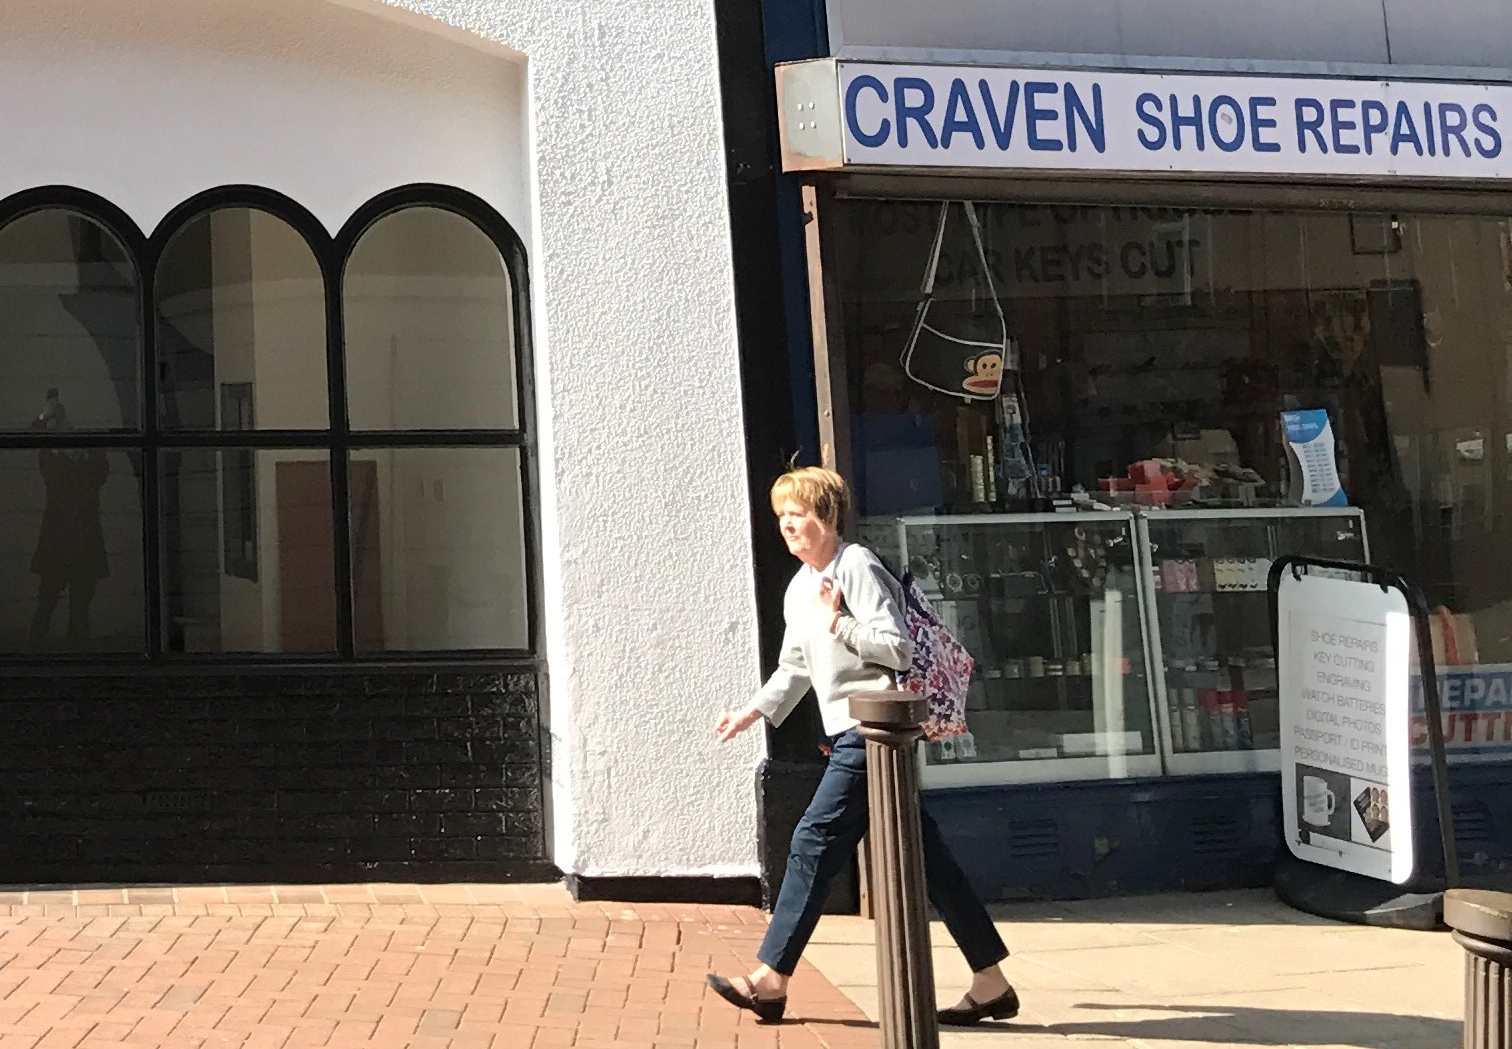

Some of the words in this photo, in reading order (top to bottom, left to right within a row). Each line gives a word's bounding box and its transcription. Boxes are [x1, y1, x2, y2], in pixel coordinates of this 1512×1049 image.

[845, 75, 1106, 152] CRAVEN
[1136, 93, 1281, 152] SHOE
[1295, 97, 1502, 159] REPAIRS
[934, 246, 1005, 286] CAR
[1014, 241, 1111, 284] KEYS
[1120, 238, 1201, 280] CUT
[1310, 630, 1337, 646] SHOE
[1338, 635, 1378, 653] REPAIRS
[1313, 650, 1332, 664] KEY
[1333, 653, 1375, 673] CUTTING
[1317, 671, 1371, 692] ENGRAVING
[1302, 688, 1335, 704] WATCH
[1336, 694, 1386, 716] BATTERIES
[1306, 709, 1340, 727] DIGITAL
[1342, 715, 1382, 736] PHOTOS
[1294, 725, 1343, 746] PASSPORT
